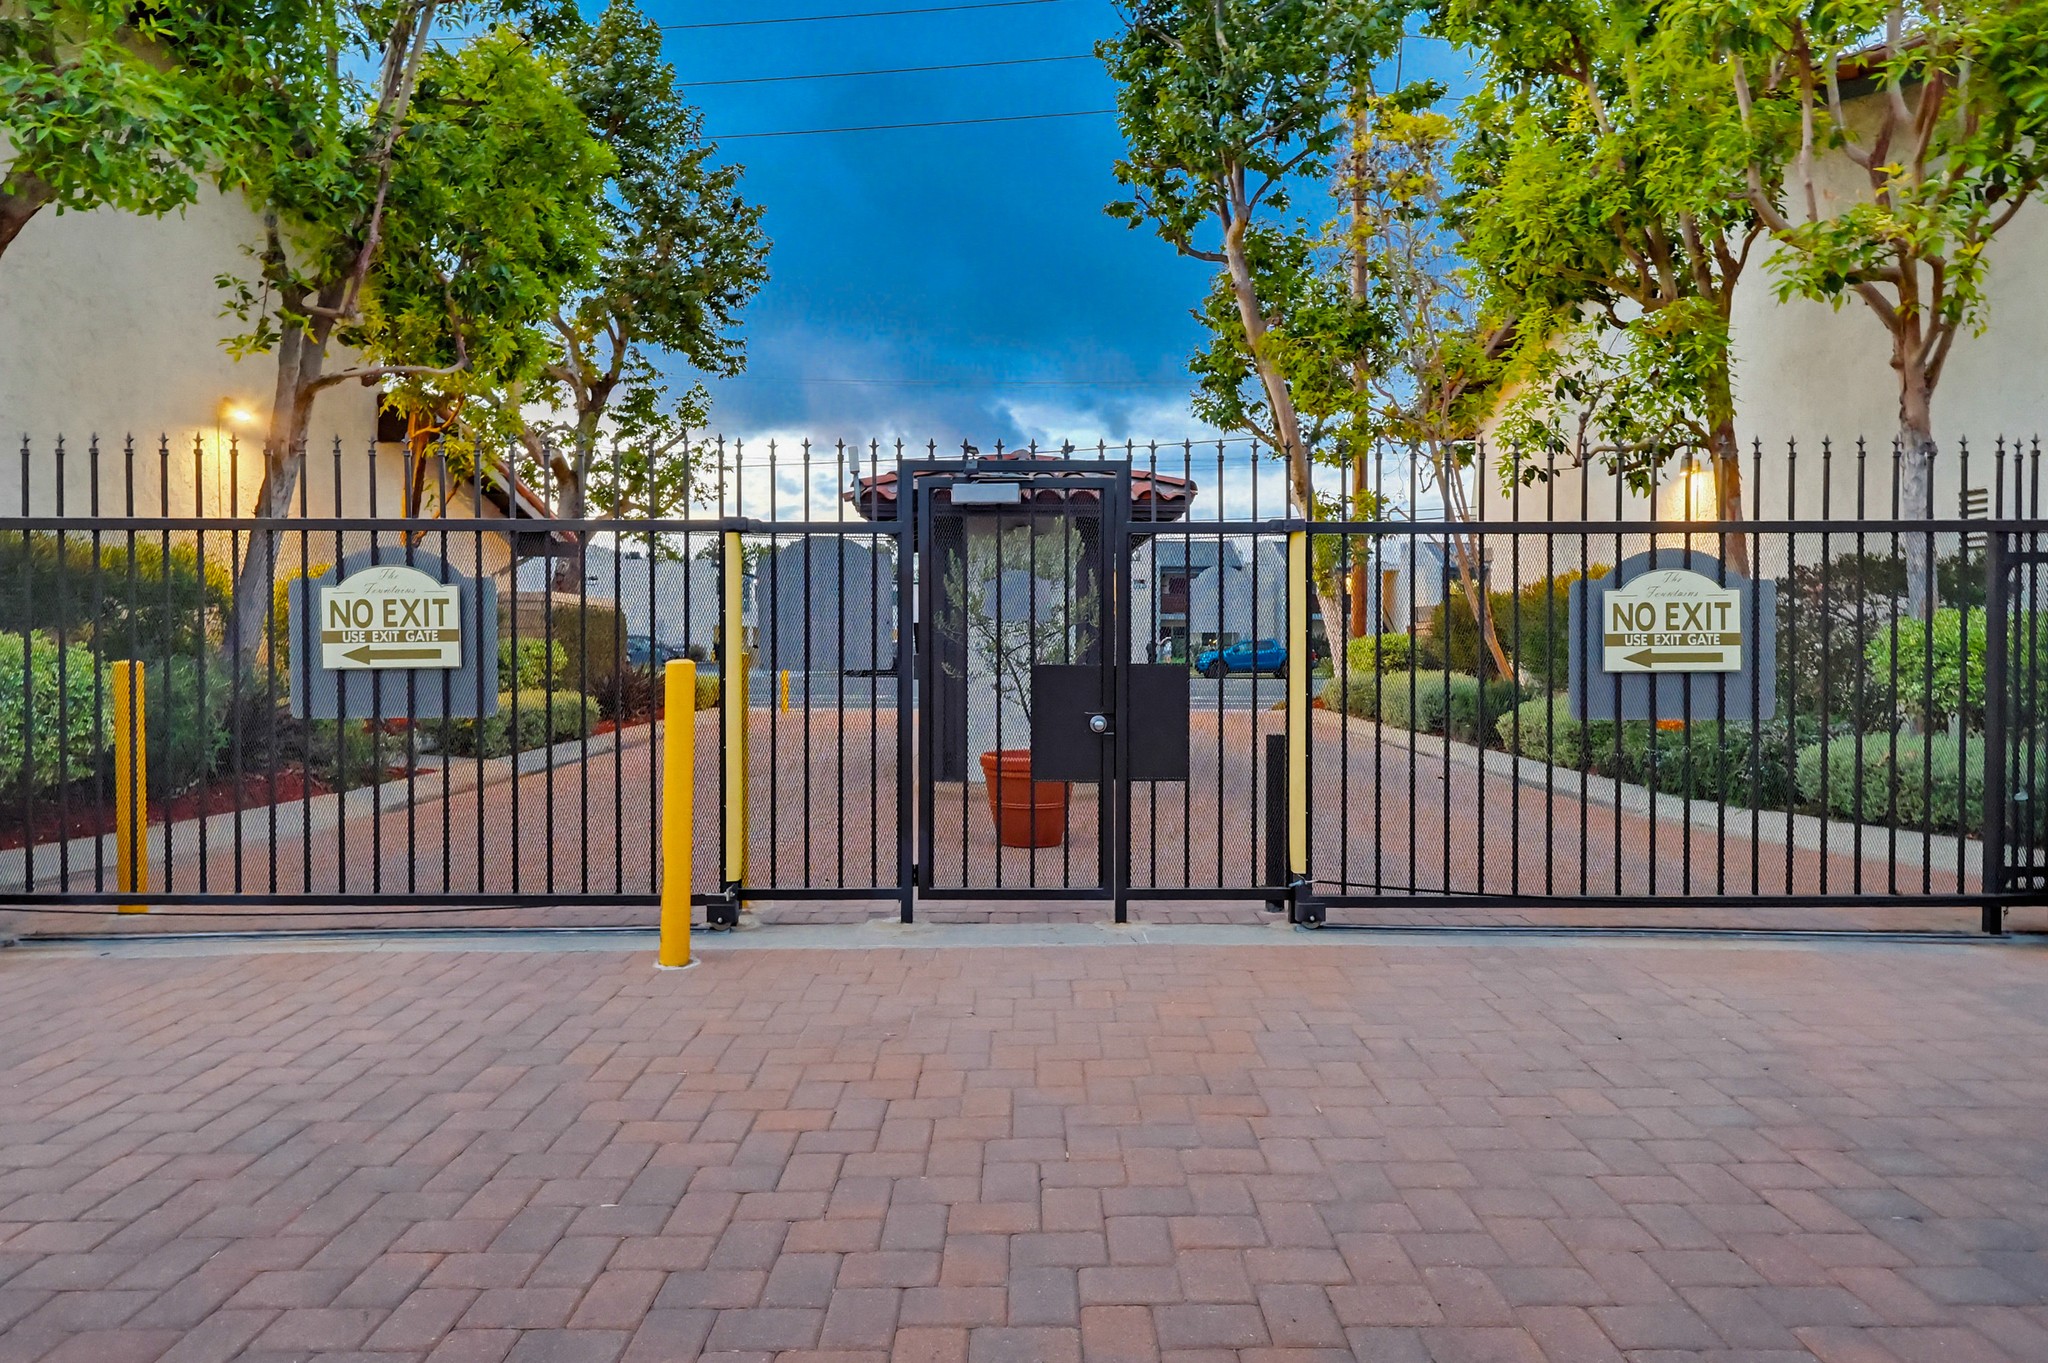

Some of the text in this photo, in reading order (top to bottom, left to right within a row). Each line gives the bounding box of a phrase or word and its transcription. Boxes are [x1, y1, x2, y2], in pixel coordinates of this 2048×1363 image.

[329, 598, 450, 629] NO EXIT
[1612, 602, 1732, 632] NO EXIT
[342, 630, 439, 643] USE EXIT GATE
[1624, 633, 1720, 646] USE EXIT GATE
